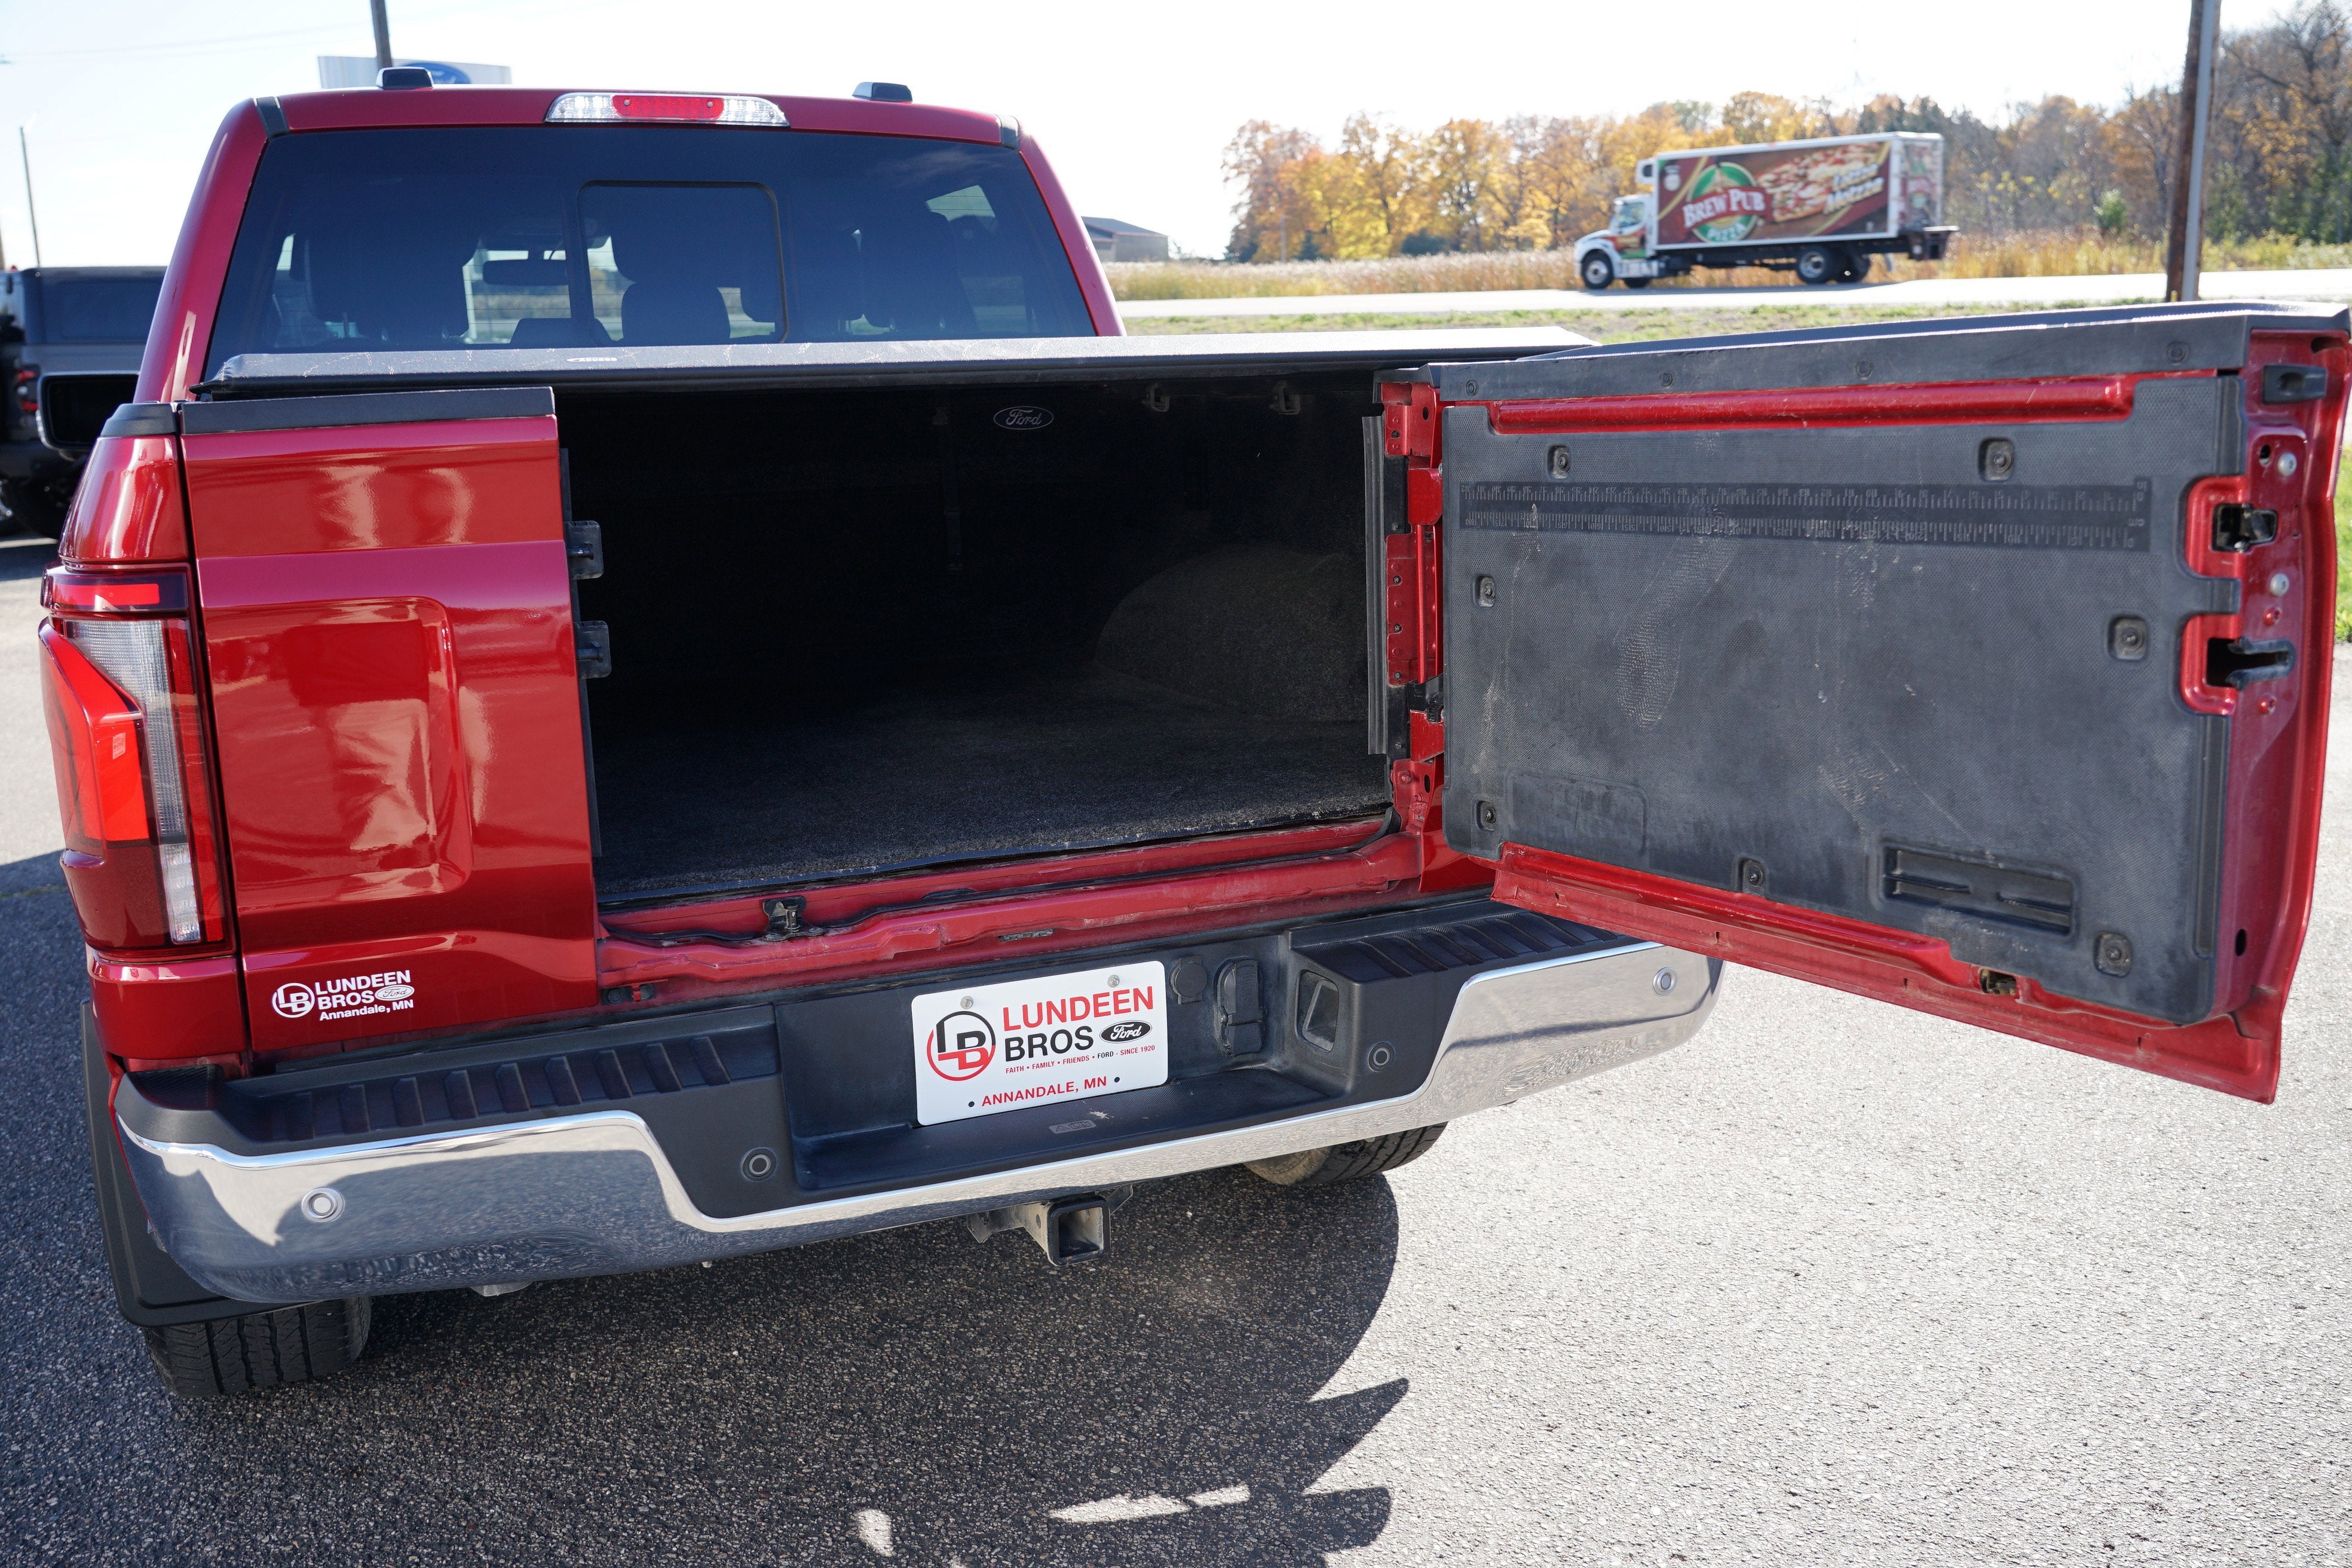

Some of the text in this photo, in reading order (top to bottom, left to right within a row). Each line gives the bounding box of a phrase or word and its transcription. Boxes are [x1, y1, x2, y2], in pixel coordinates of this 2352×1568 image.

[1683, 188, 1765, 228] BREW PUB
[1006, 409, 1042, 425] Ford
[315, 970, 411, 995] LUNDEEN
[383, 988, 407, 997] Ford
[317, 990, 375, 1010] BROS
[320, 999, 414, 1021] Annandale, MN
[1003, 986, 1153, 1031] LUNDEEN
[1110, 1024, 1141, 1040] Ford
[1005, 1026, 1094, 1061] BROS
[1032, 1061, 1055, 1070] FAMILY
[1062, 1055, 1090, 1065] FRIENDS
[1120, 1048, 1138, 1056] SINCE
[982, 1076, 1107, 1106] ANNANDALE, MN
